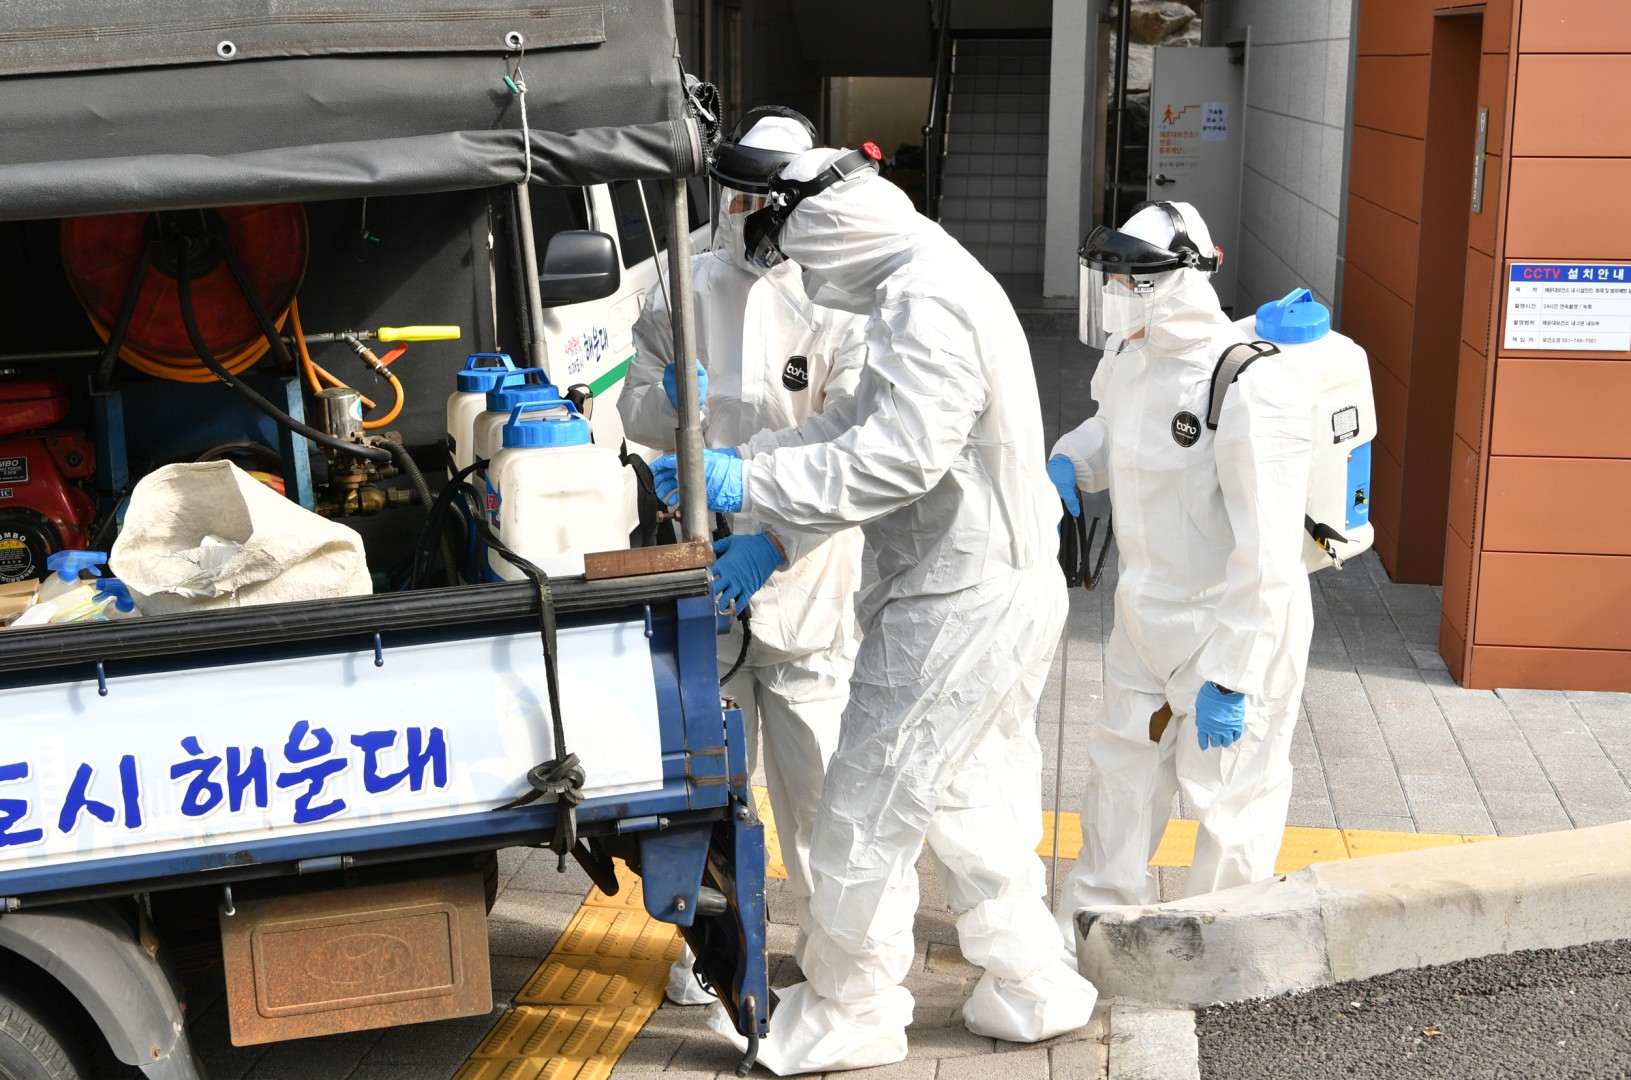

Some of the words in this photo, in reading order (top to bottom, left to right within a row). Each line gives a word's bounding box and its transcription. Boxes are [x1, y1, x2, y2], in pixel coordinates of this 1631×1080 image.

[1523, 267, 1561, 279] CCTV
[1176, 419, 1197, 435] boho
[170, 719, 449, 825] 해운대
